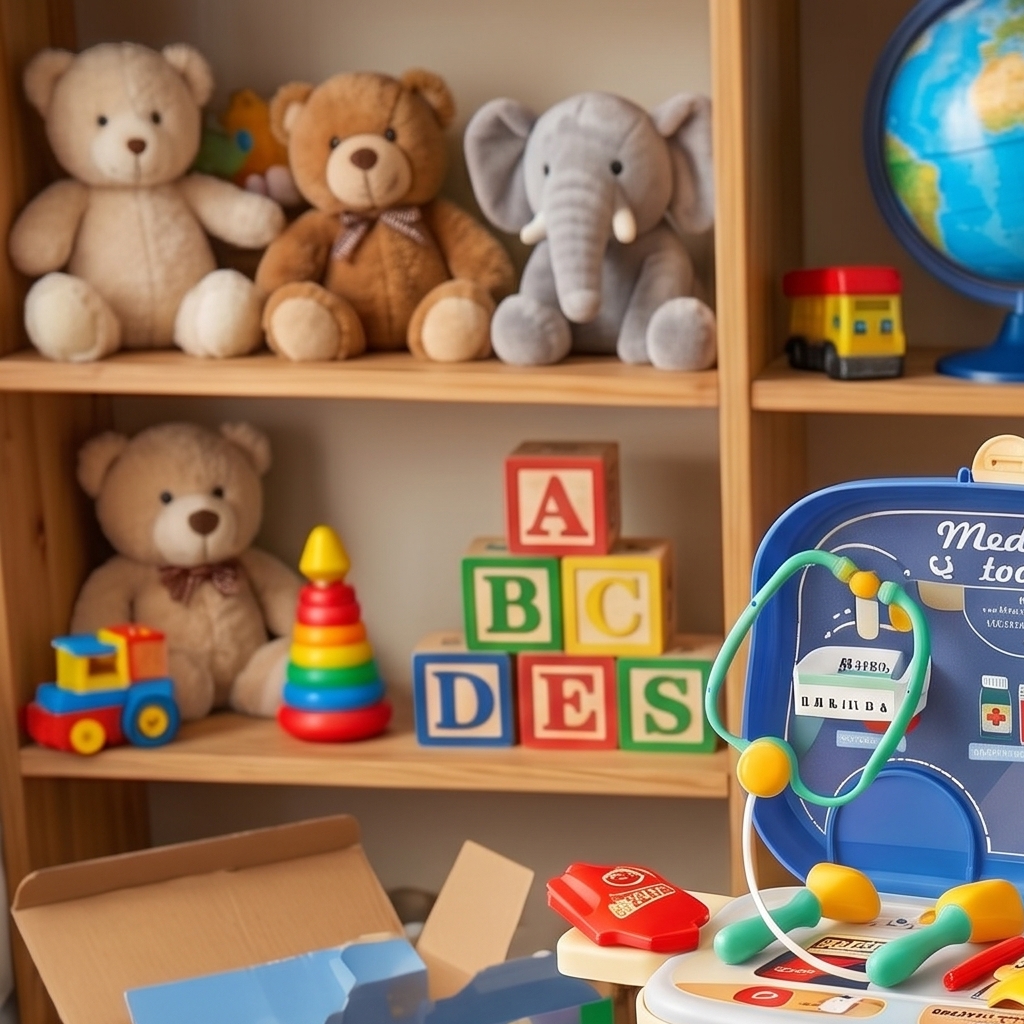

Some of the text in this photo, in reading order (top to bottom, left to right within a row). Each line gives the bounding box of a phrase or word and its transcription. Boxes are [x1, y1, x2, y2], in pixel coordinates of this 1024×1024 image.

[526, 475, 589, 537] A
[483, 575, 642, 638] B C
[431, 671, 692, 735] D E S
